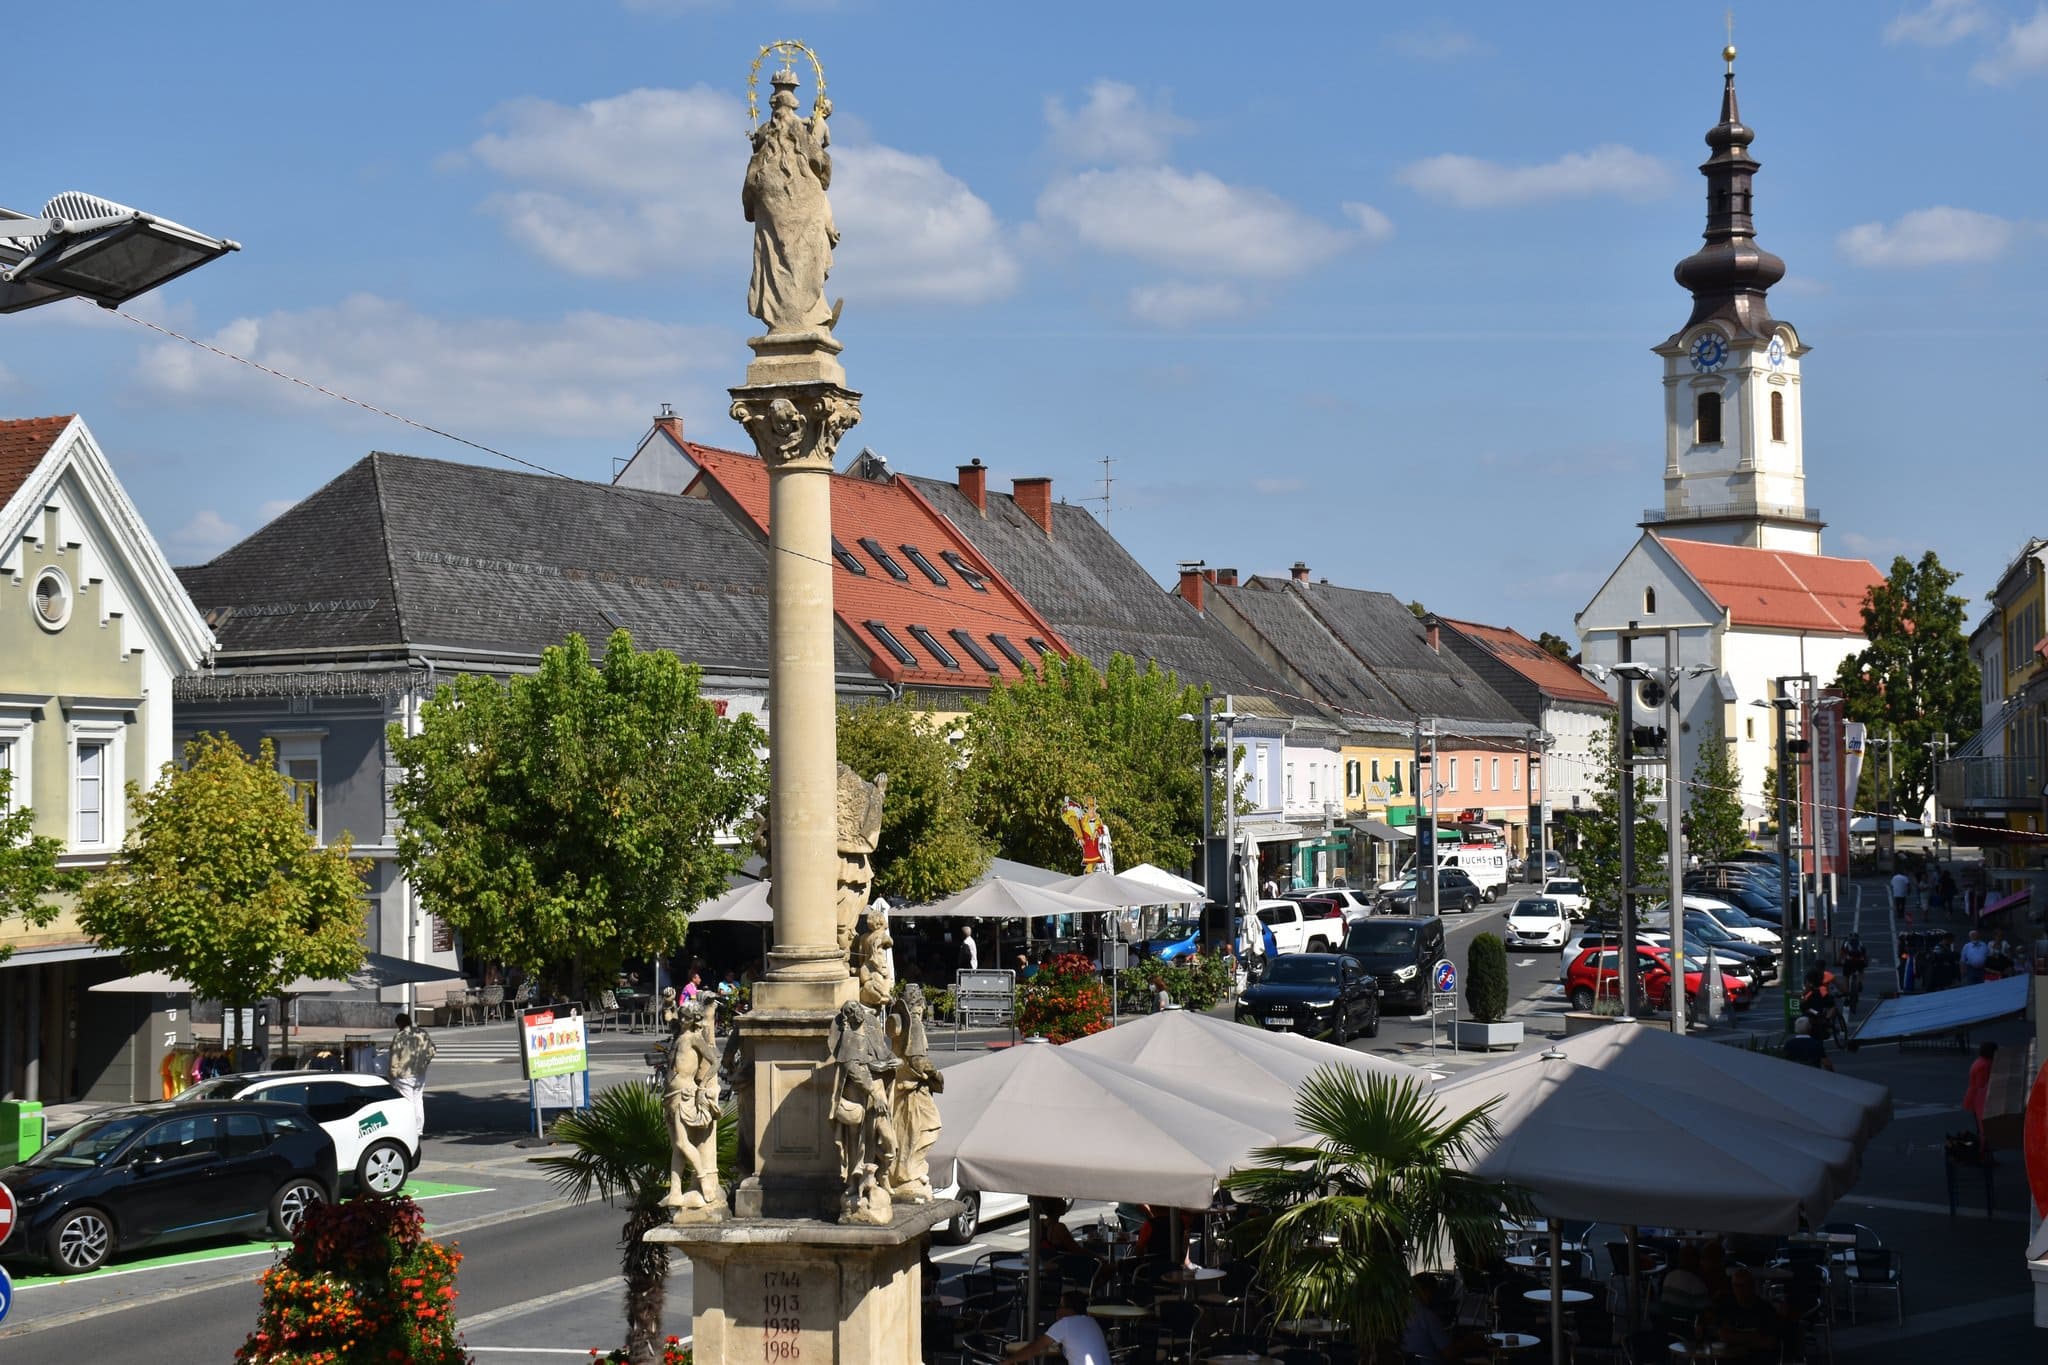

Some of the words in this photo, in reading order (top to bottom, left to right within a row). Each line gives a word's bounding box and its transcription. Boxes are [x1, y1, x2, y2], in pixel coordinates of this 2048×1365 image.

[1848, 737, 1862, 749] dm
[1462, 856, 1486, 865] FUCHS
[534, 1053, 581, 1068] Hauptbahnhof
[764, 1271, 800, 1288] 1744
[763, 1295, 800, 1315] 1913
[763, 1318, 800, 1339] 1938
[763, 1337, 800, 1364] 1986
